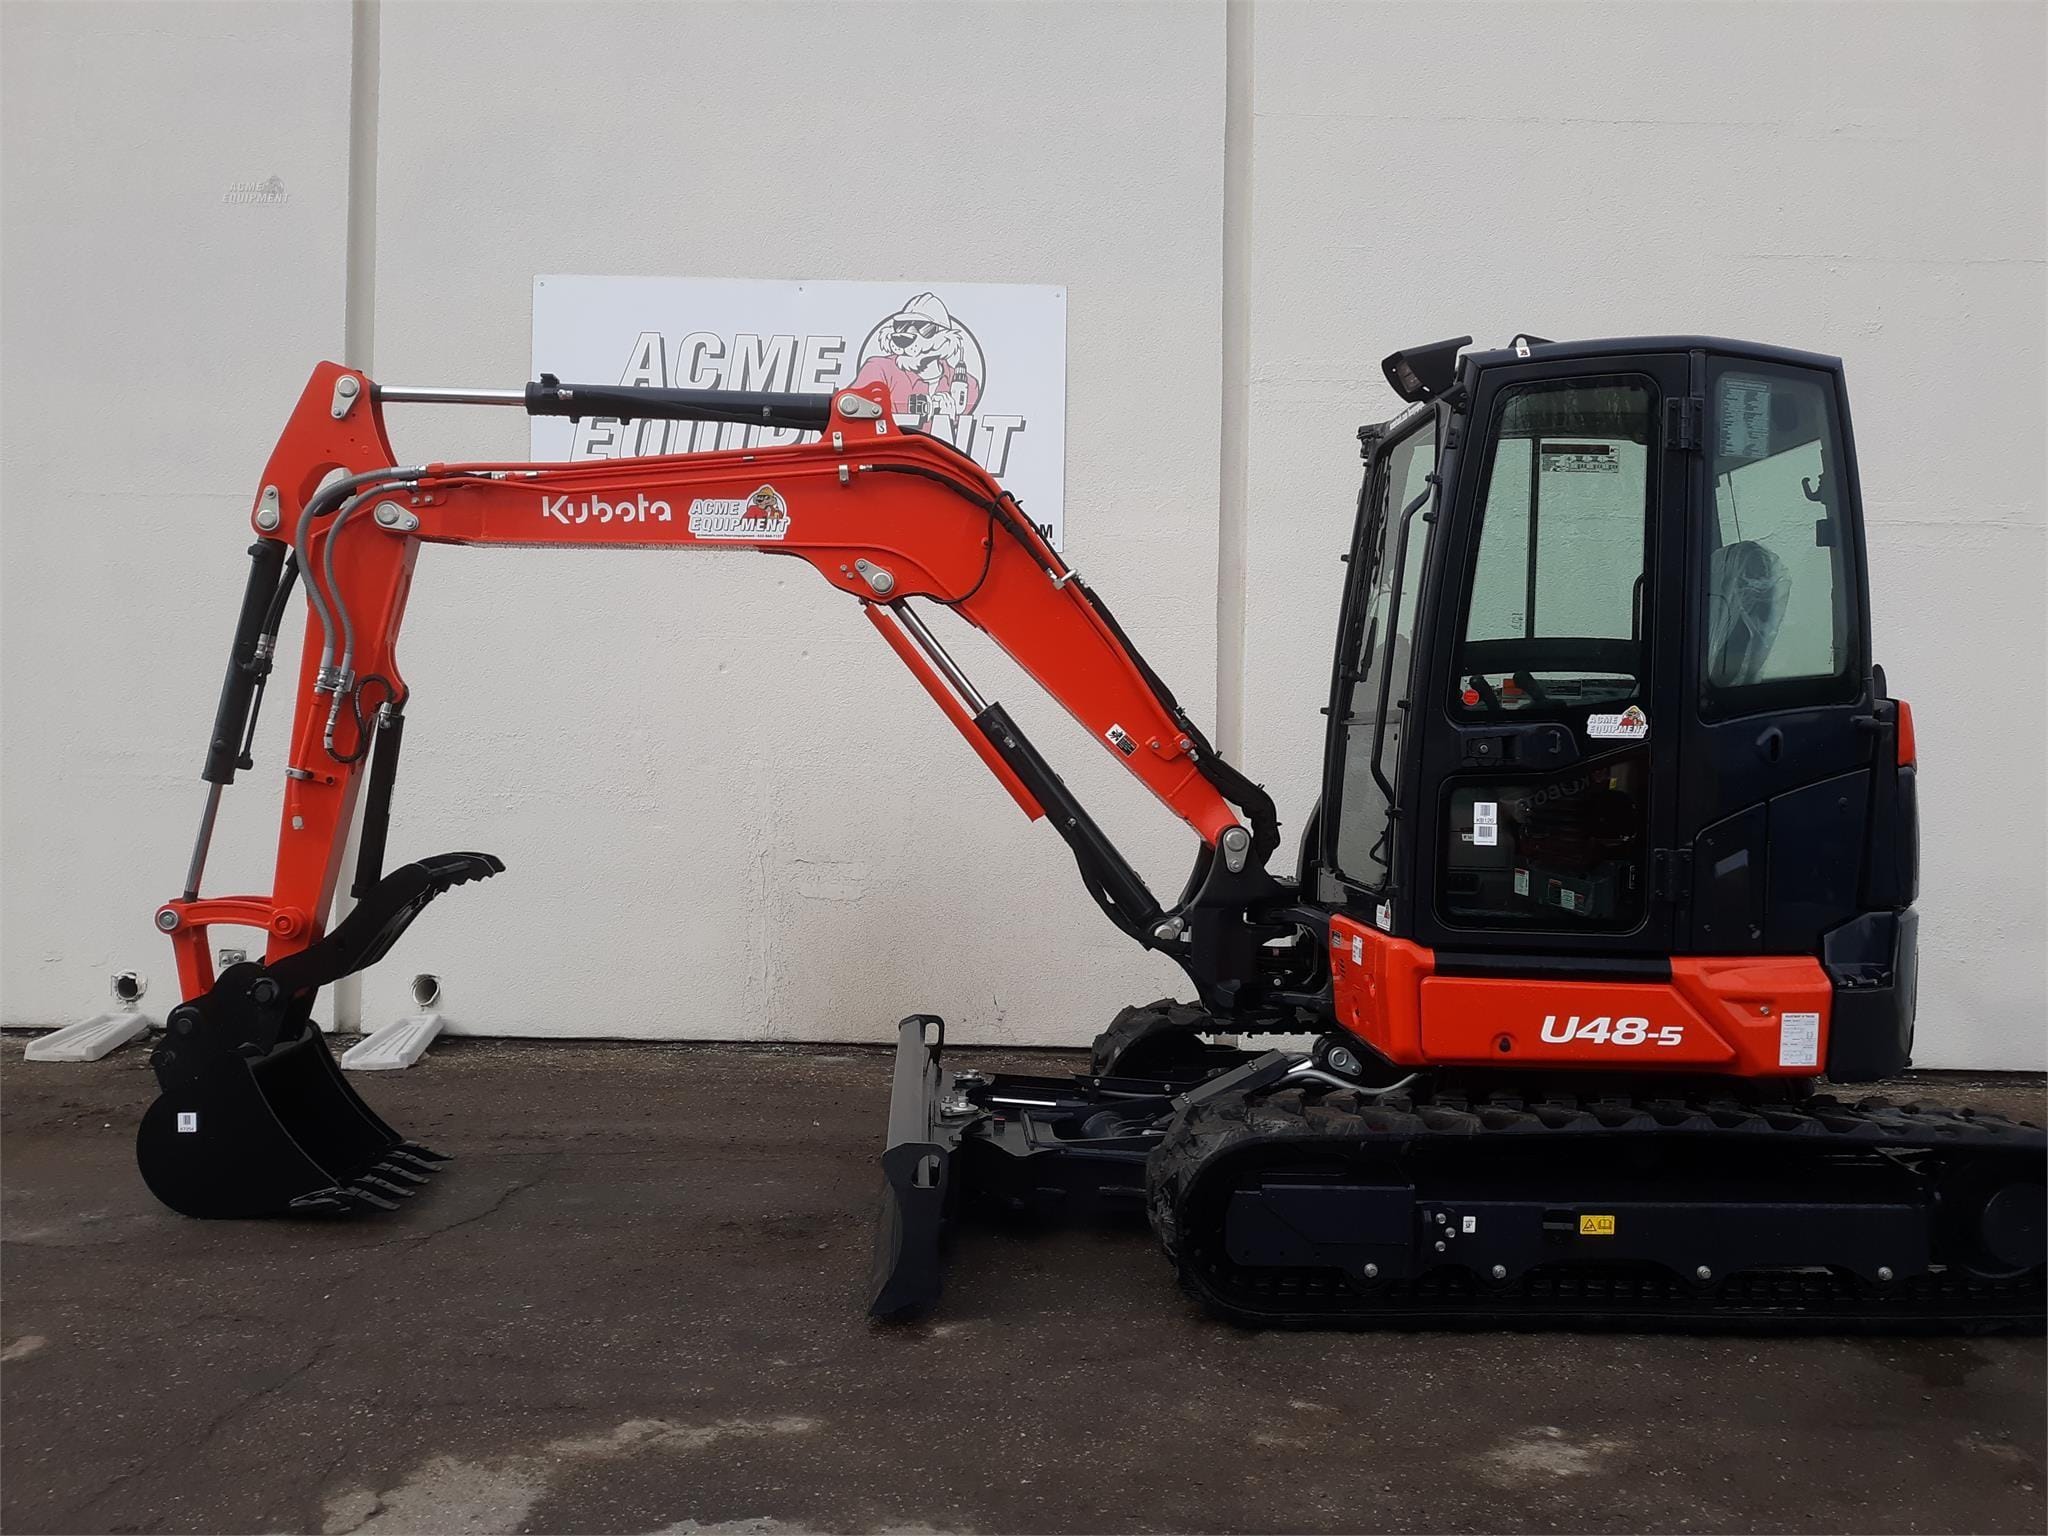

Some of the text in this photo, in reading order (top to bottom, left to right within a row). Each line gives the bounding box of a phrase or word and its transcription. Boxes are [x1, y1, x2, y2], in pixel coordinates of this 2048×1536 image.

[618, 331, 846, 394] ACME
[542, 493, 672, 524] Kubota
[691, 501, 740, 515] ACME
[690, 517, 788, 533] EQUIPMENT
[1589, 716, 1619, 725] ACME
[1588, 724, 1648, 735] EQUIPMENT
[1540, 1015, 1684, 1046] U48-5
